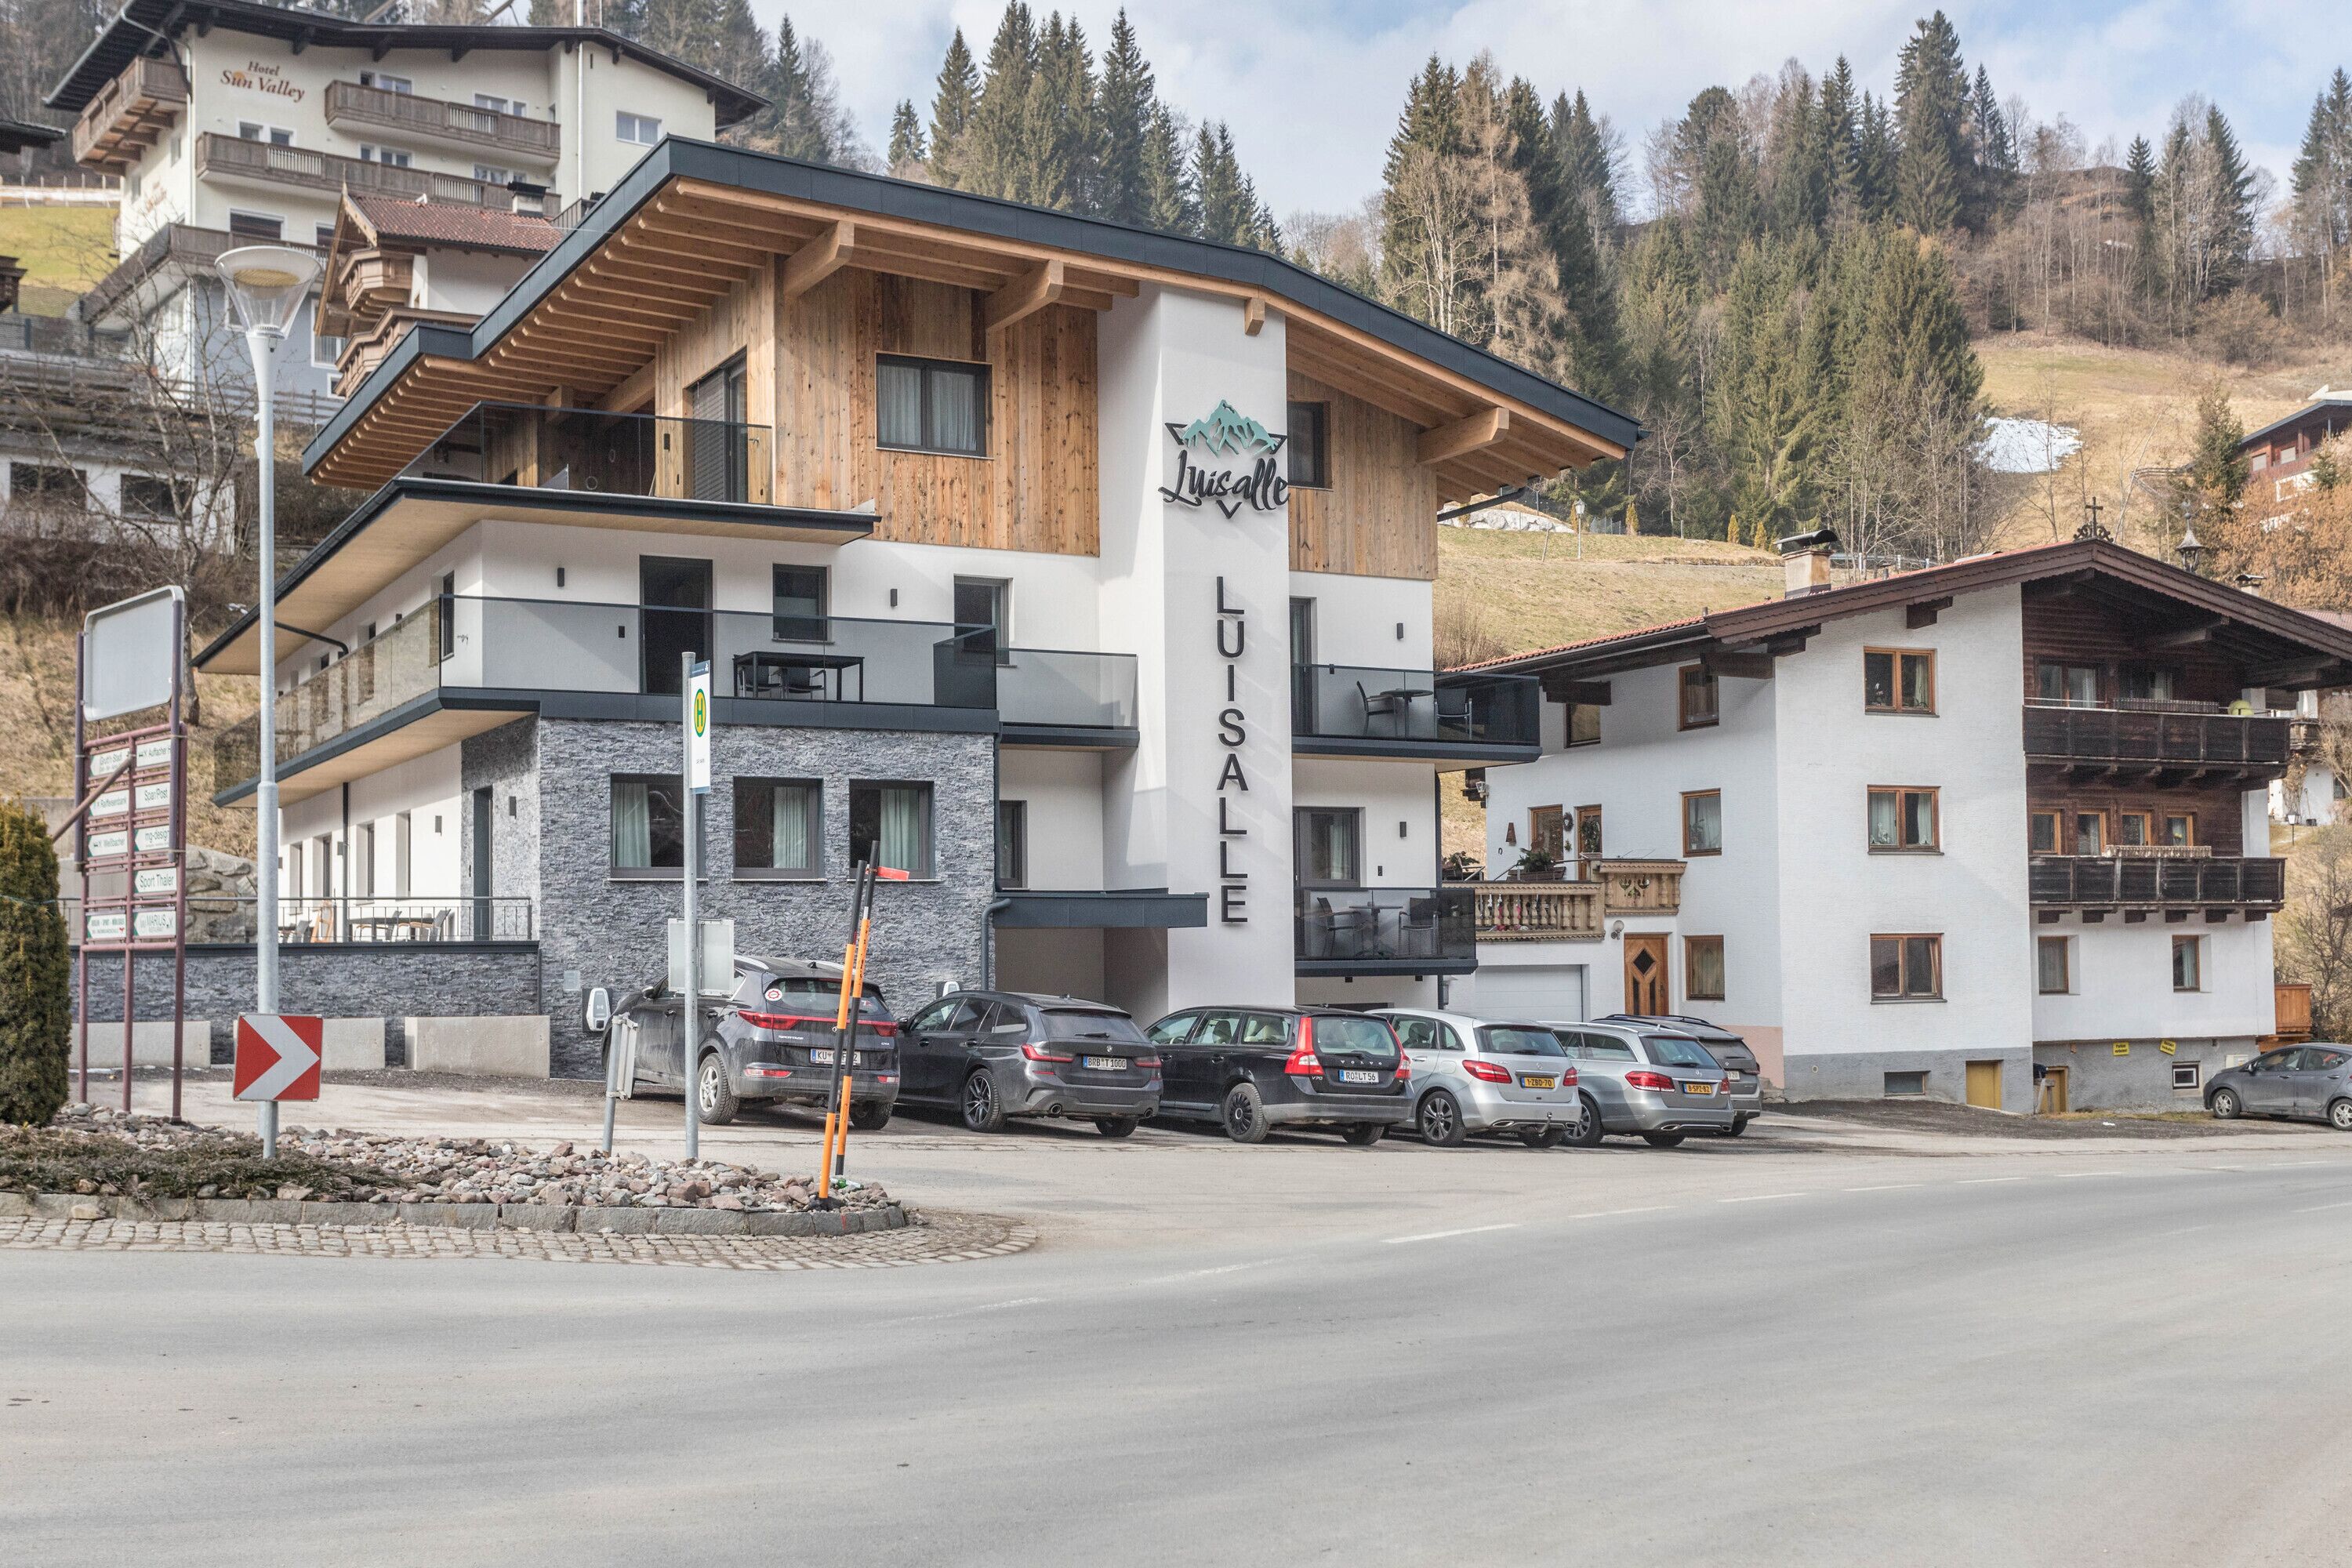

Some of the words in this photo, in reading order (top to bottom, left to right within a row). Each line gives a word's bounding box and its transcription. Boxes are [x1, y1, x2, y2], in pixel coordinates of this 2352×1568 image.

[248, 61, 280, 76] Hotel
[220, 69, 252, 89] Sun
[258, 77, 305, 103] Valley
[1157, 449, 1290, 511] Luisalle
[1216, 575, 1249, 924] LUISALLE
[140, 875, 154, 889] Sport
[157, 873, 174, 886] Thaler
[147, 914, 166, 927] MARIUS
[817, 1051, 827, 1060] KU
[1088, 1058, 1101, 1067] BRB
[1110, 1059, 1126, 1068] 1000
[1367, 1073, 1376, 1081] 56
